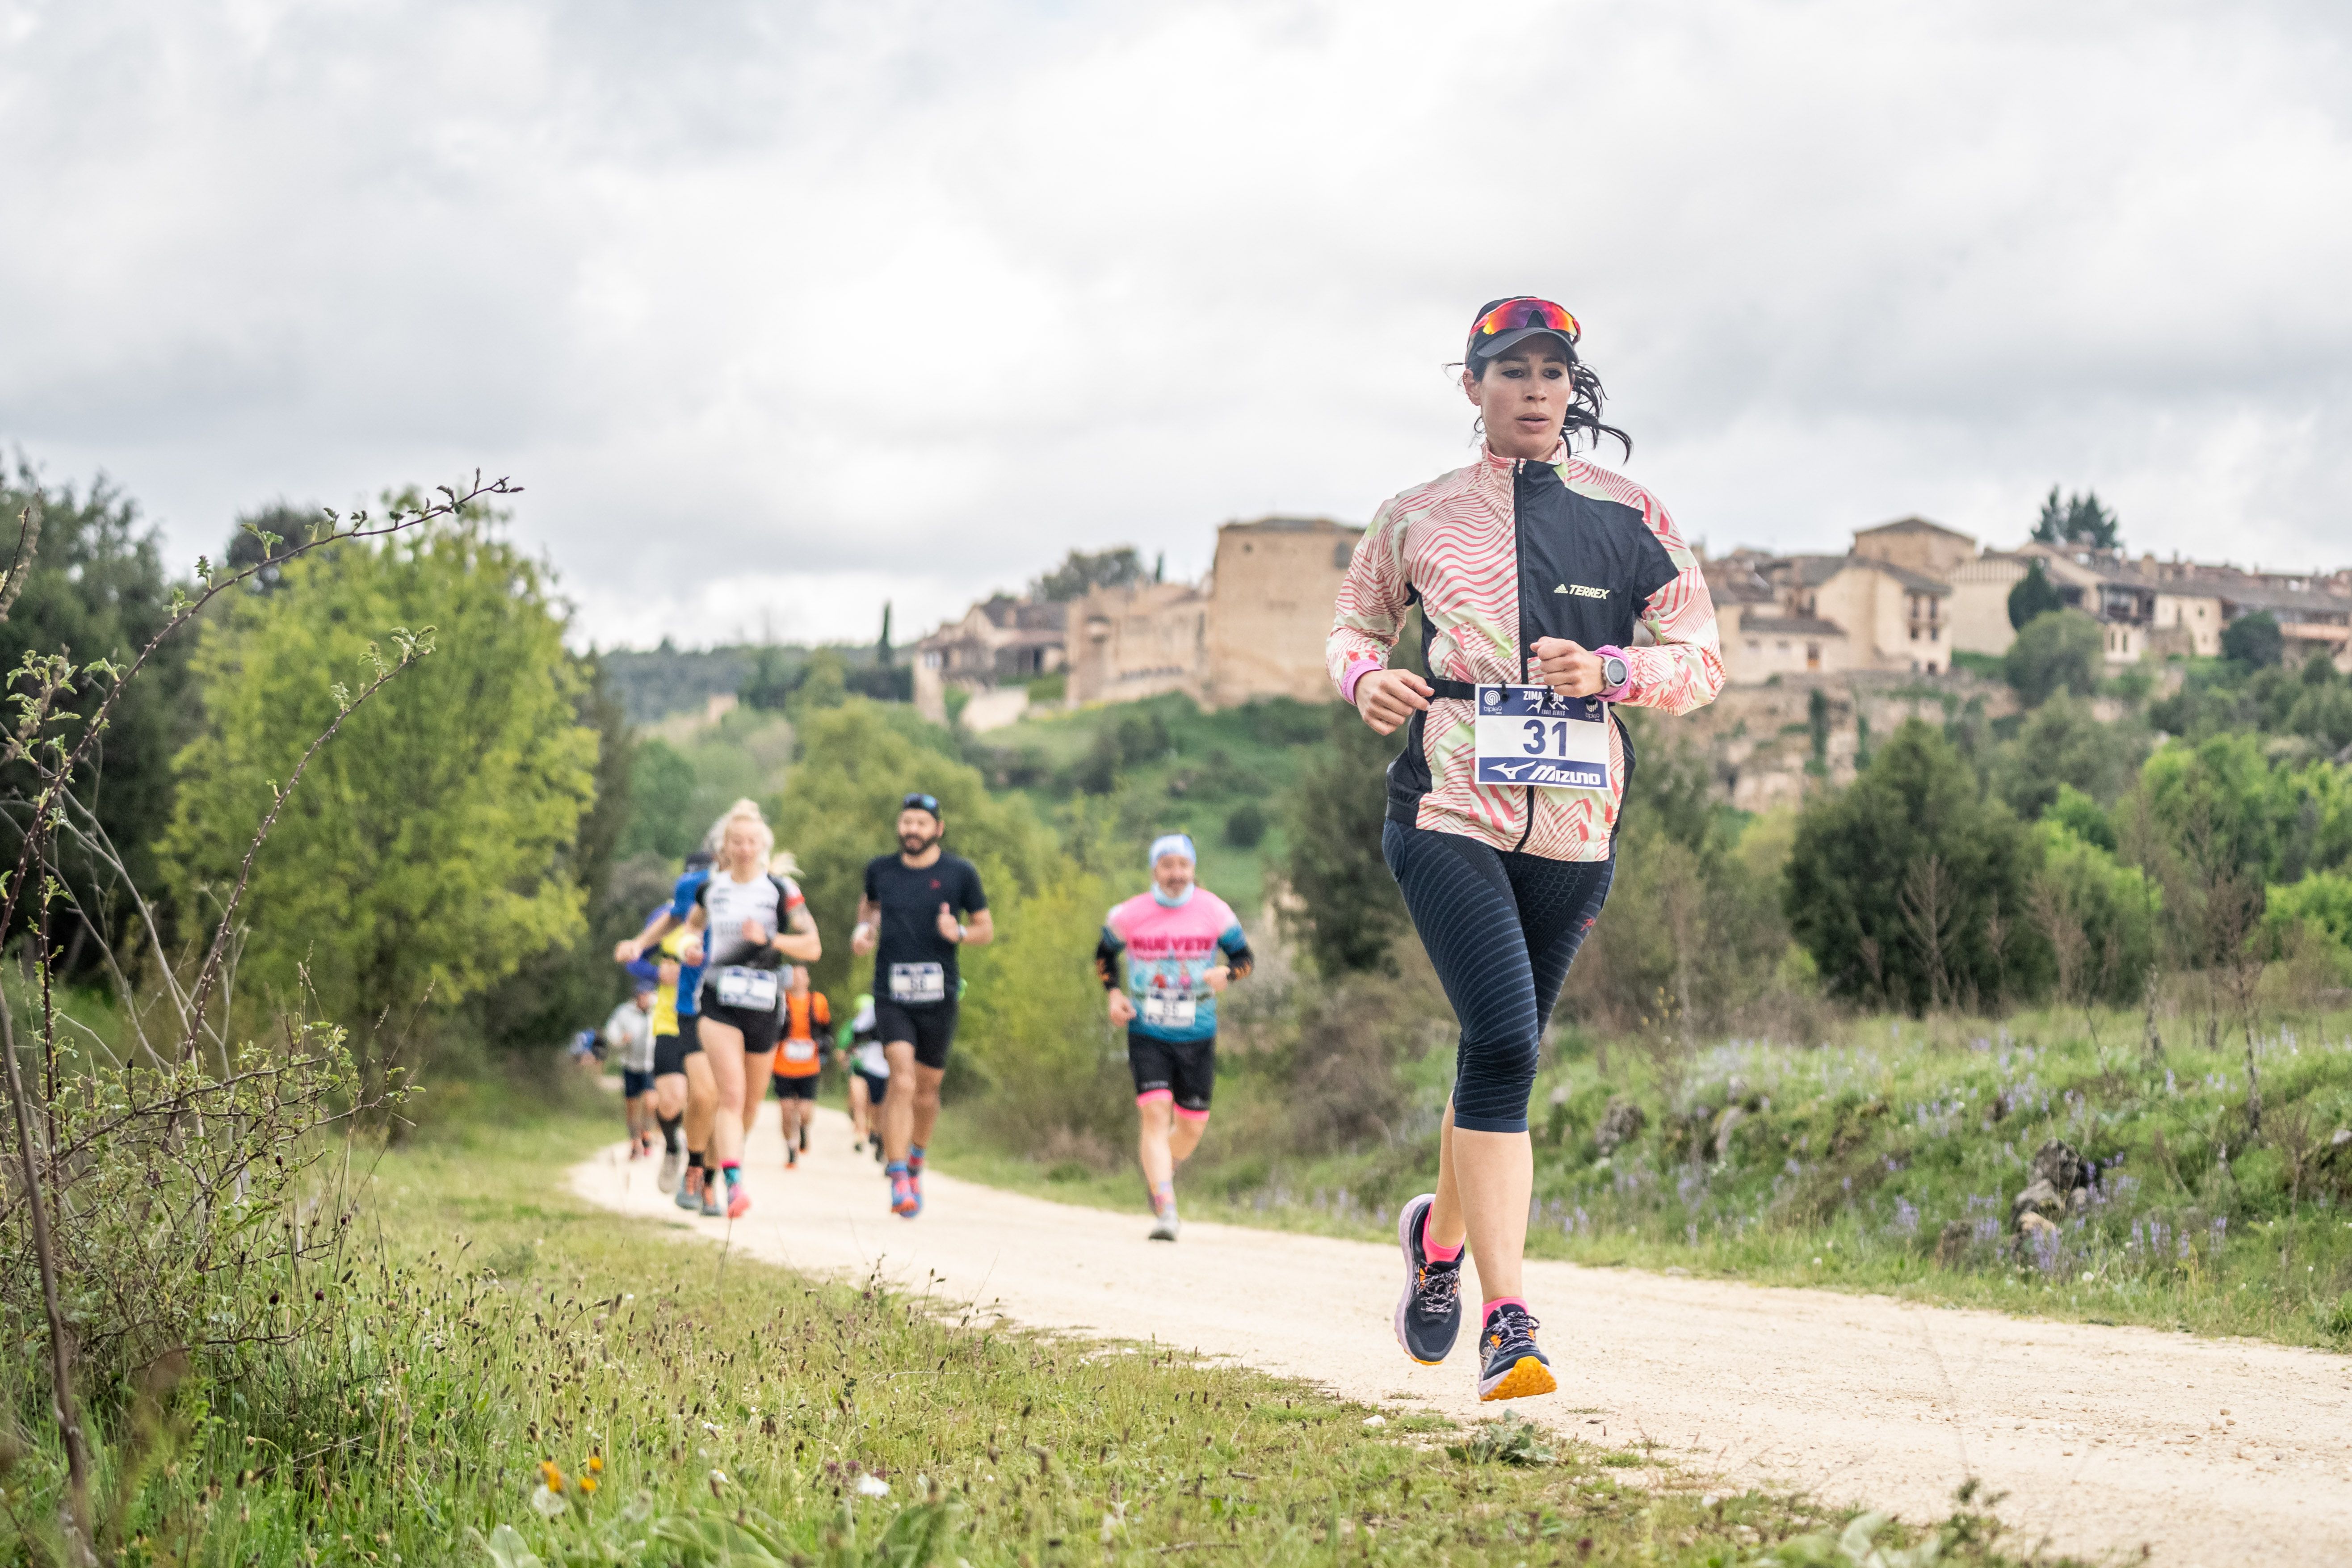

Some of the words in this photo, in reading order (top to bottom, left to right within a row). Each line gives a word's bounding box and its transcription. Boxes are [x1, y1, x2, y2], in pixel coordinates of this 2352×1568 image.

[1569, 584, 1610, 600] TERREX
[1523, 691, 1543, 701] ZIMA
[1523, 719, 1567, 757] 31
